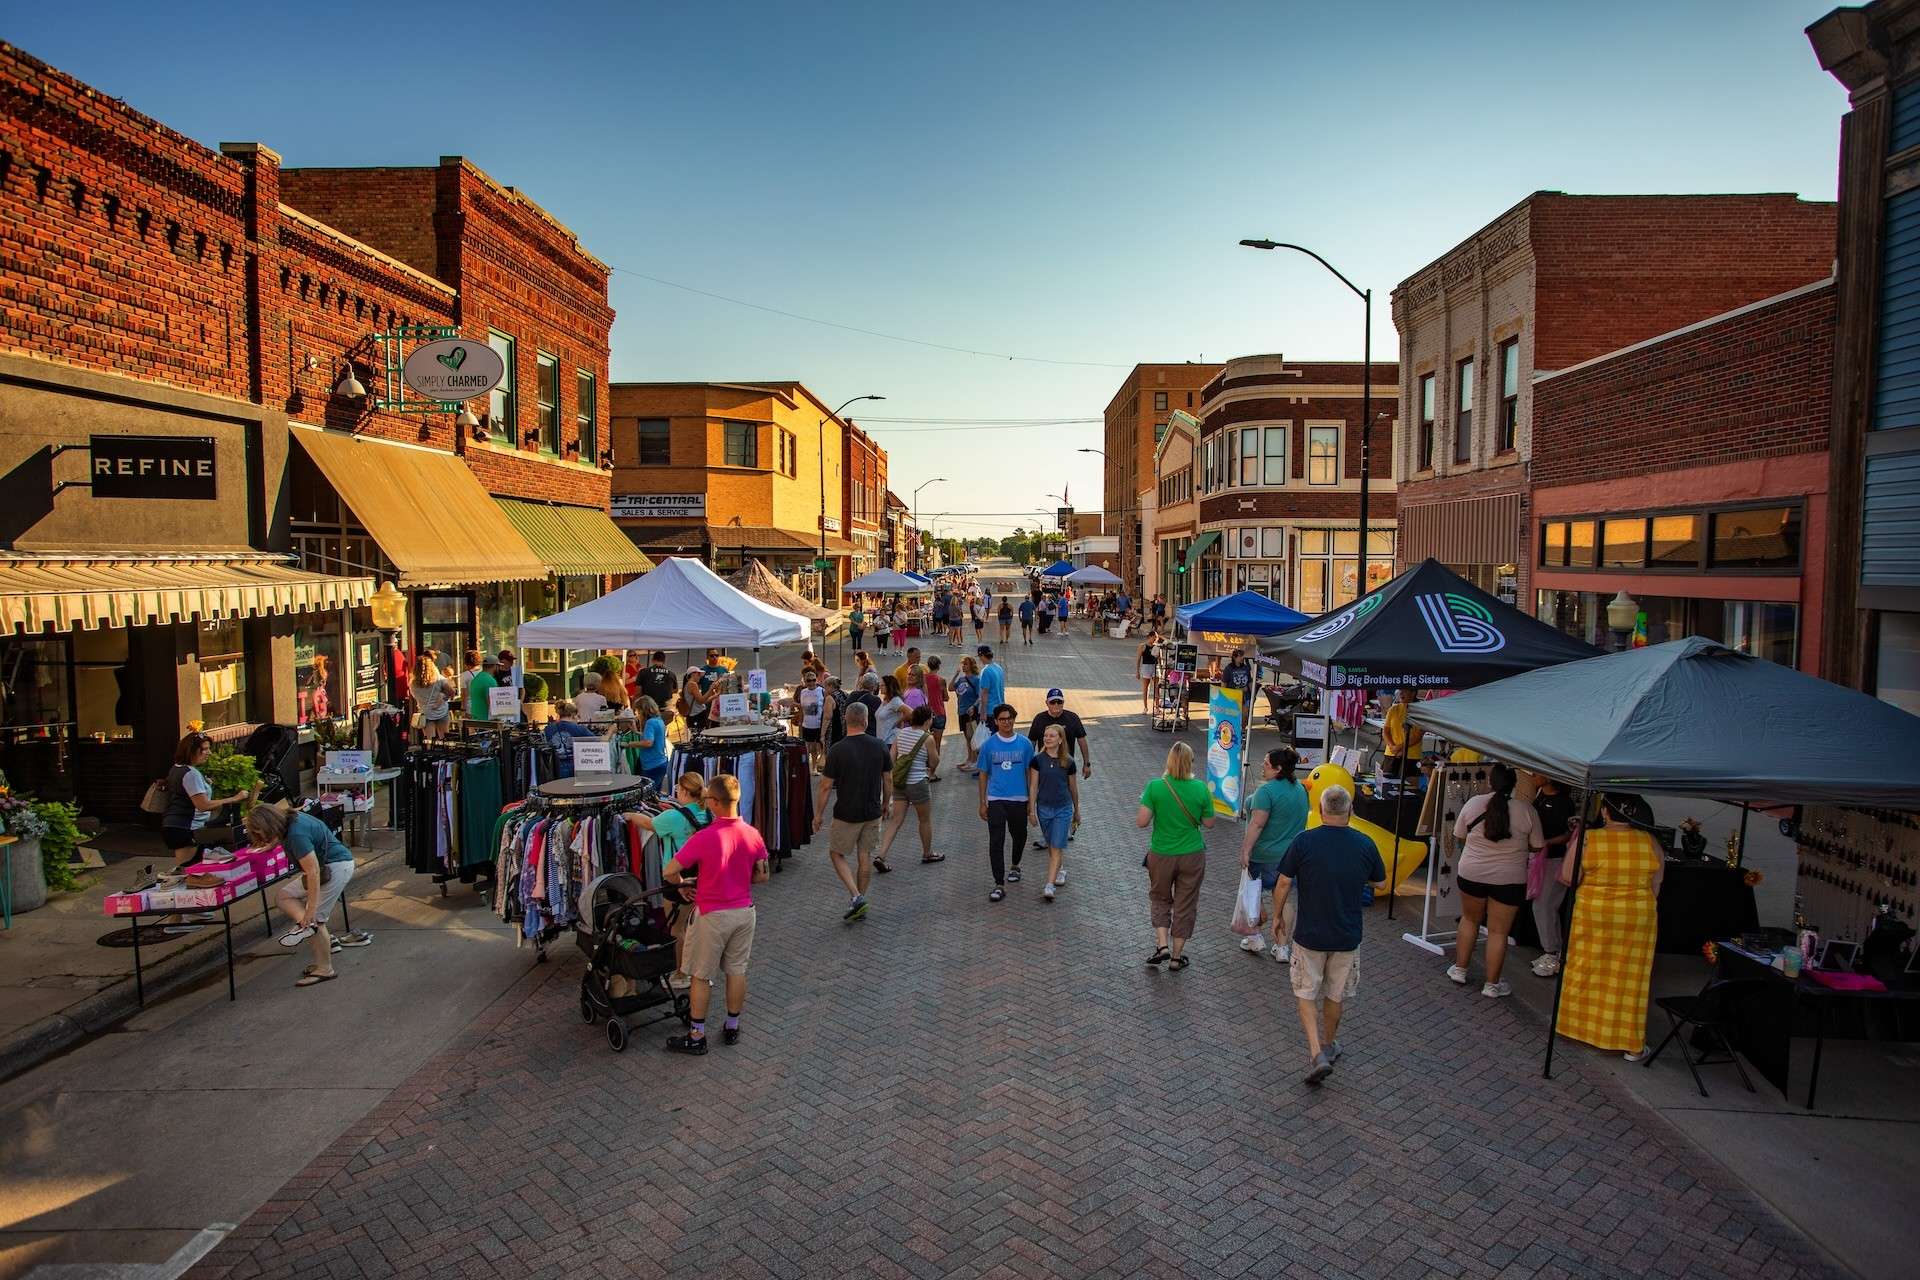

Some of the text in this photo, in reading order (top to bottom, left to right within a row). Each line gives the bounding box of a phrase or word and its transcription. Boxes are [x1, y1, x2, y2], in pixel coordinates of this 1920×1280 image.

[416, 375, 489, 387] SIMPLY CHARMED
[94, 457, 213, 477] REFINE
[1347, 674, 1449, 687] Big Brothers Big Sisters
